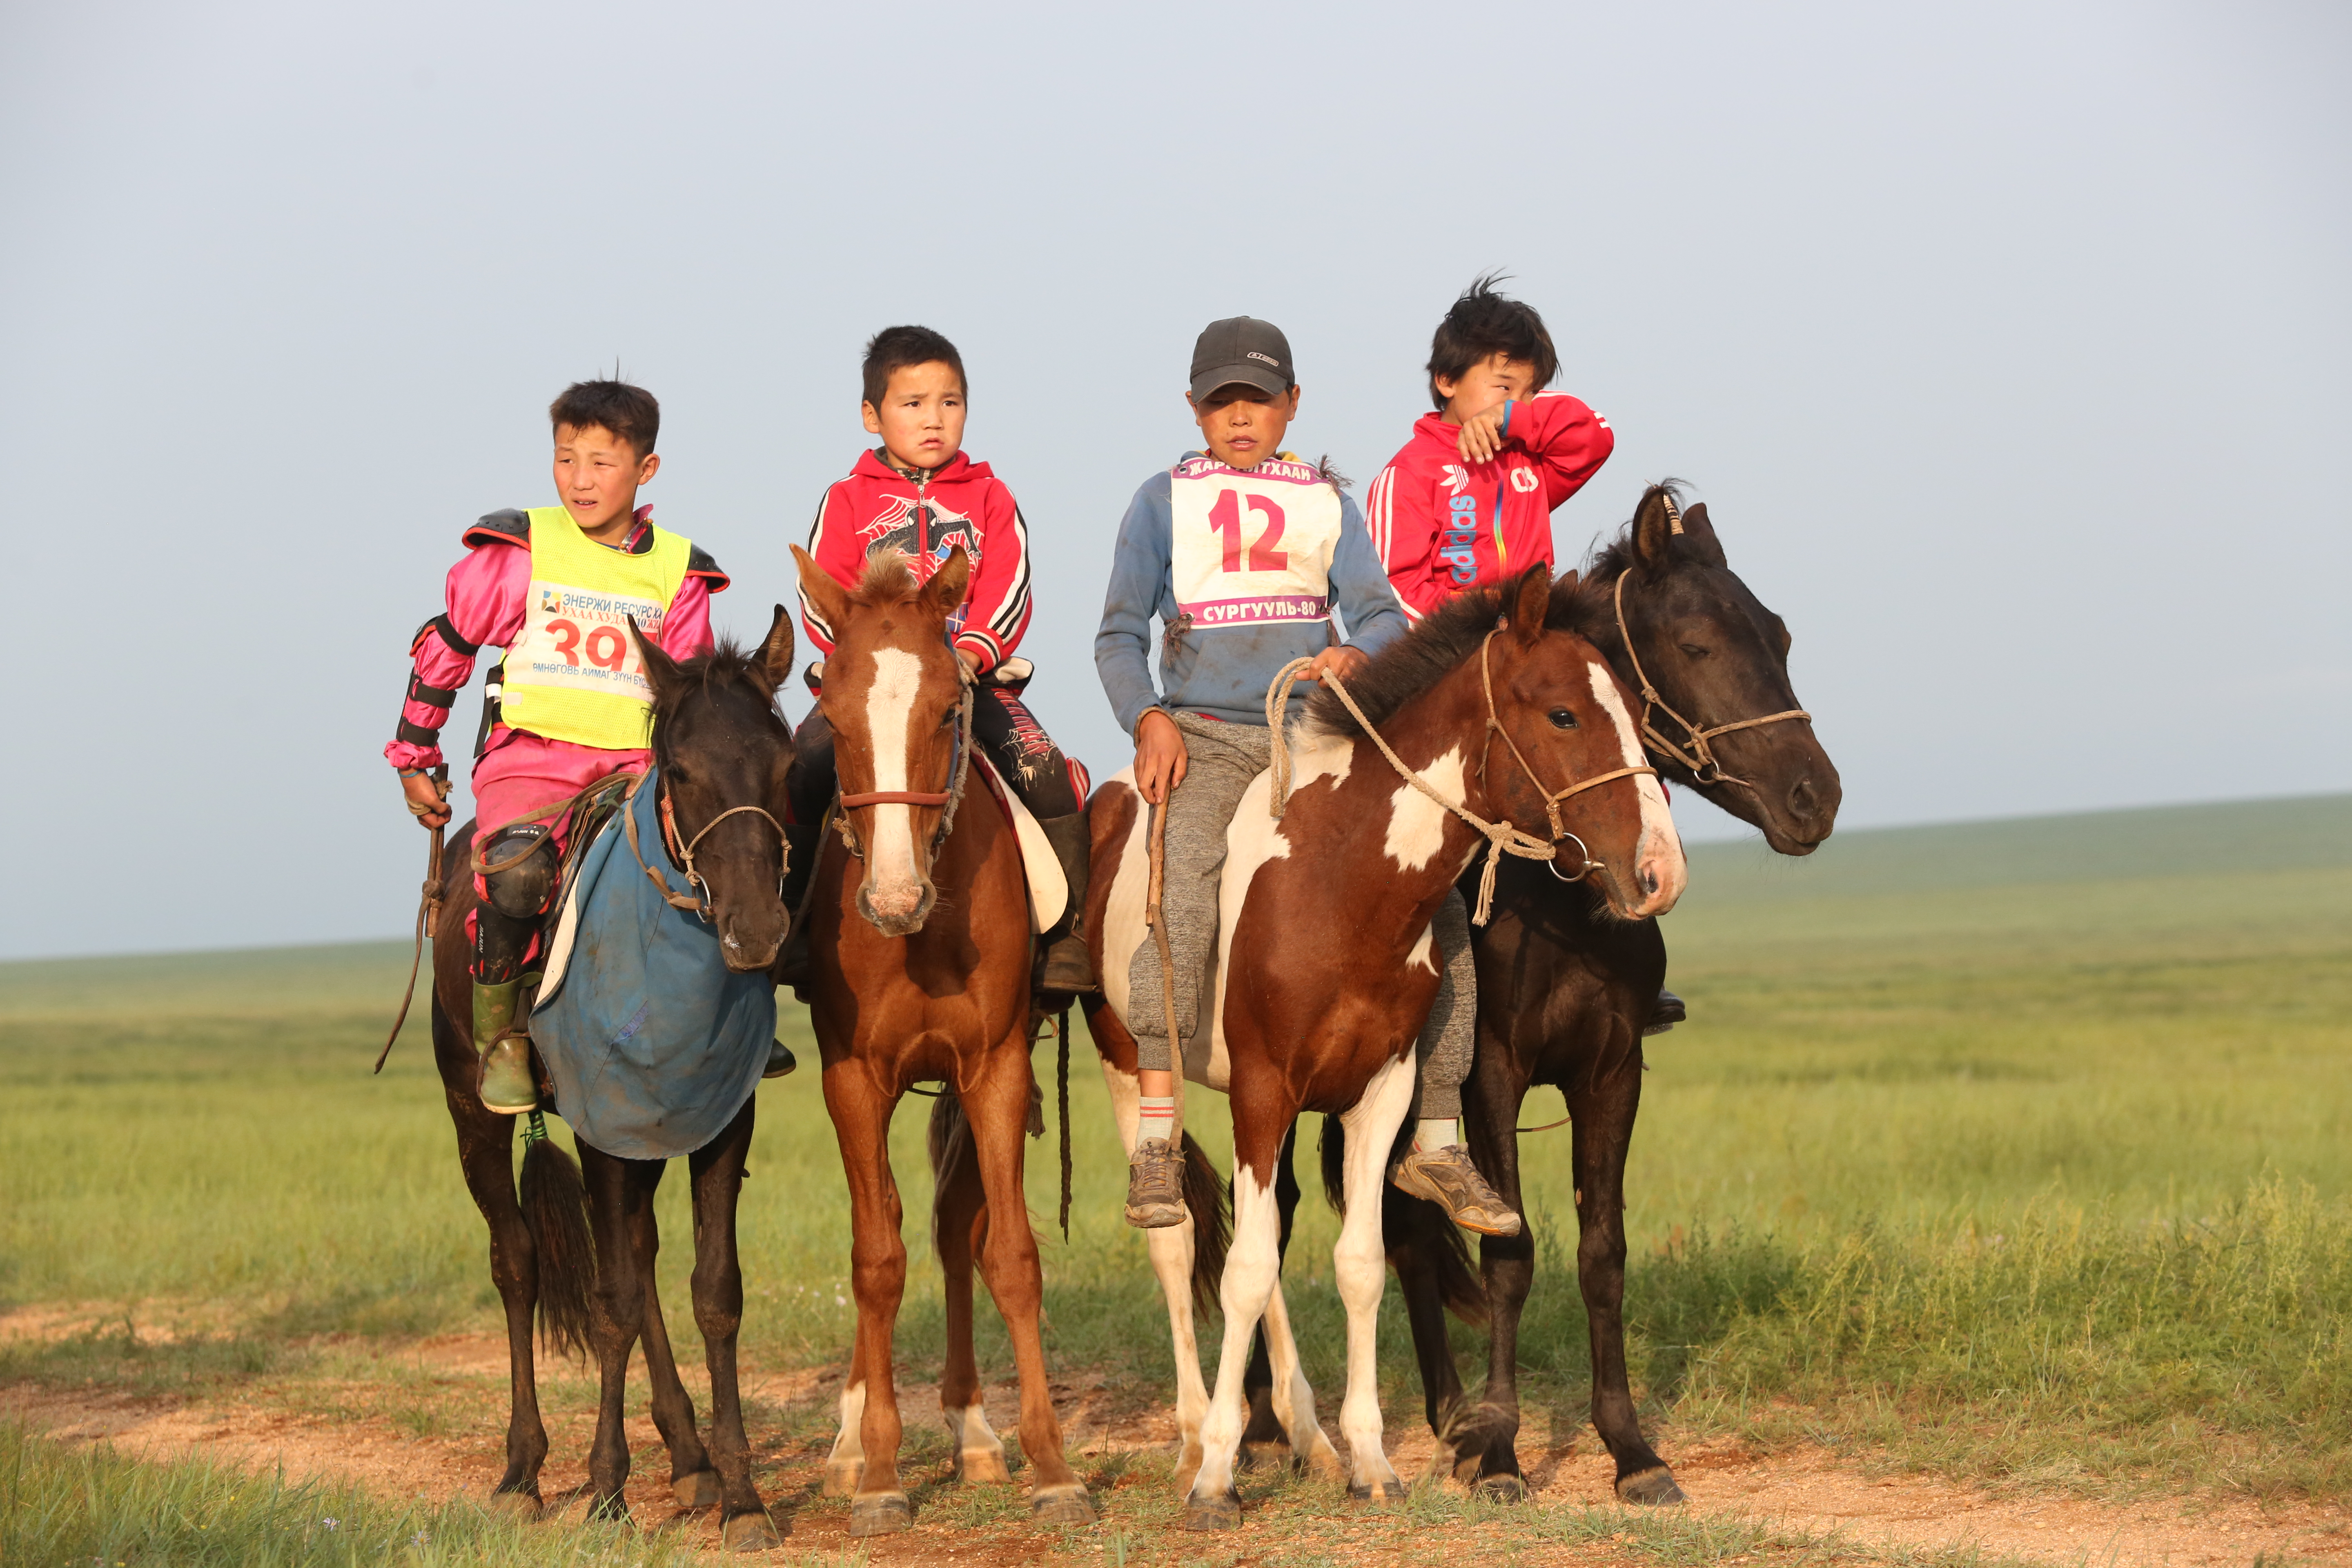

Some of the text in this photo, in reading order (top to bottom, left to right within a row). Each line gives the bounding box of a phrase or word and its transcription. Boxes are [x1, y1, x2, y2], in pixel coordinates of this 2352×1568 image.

[1189, 461, 1311, 481] ЖАРТХААН
[1208, 489, 1288, 572] 12
[1440, 495, 1478, 584] adidas
[563, 593, 611, 612] ЭНЕРЖИ
[614, 601, 652, 618] РЕСУРС
[1203, 601, 1316, 621] СУРГУУЛЬ-80
[562, 606, 592, 620] УХАА
[597, 611, 629, 626] ХУДА
[637, 618, 646, 628] 10
[533, 663, 579, 675] ӨМНӨГОВЬ
